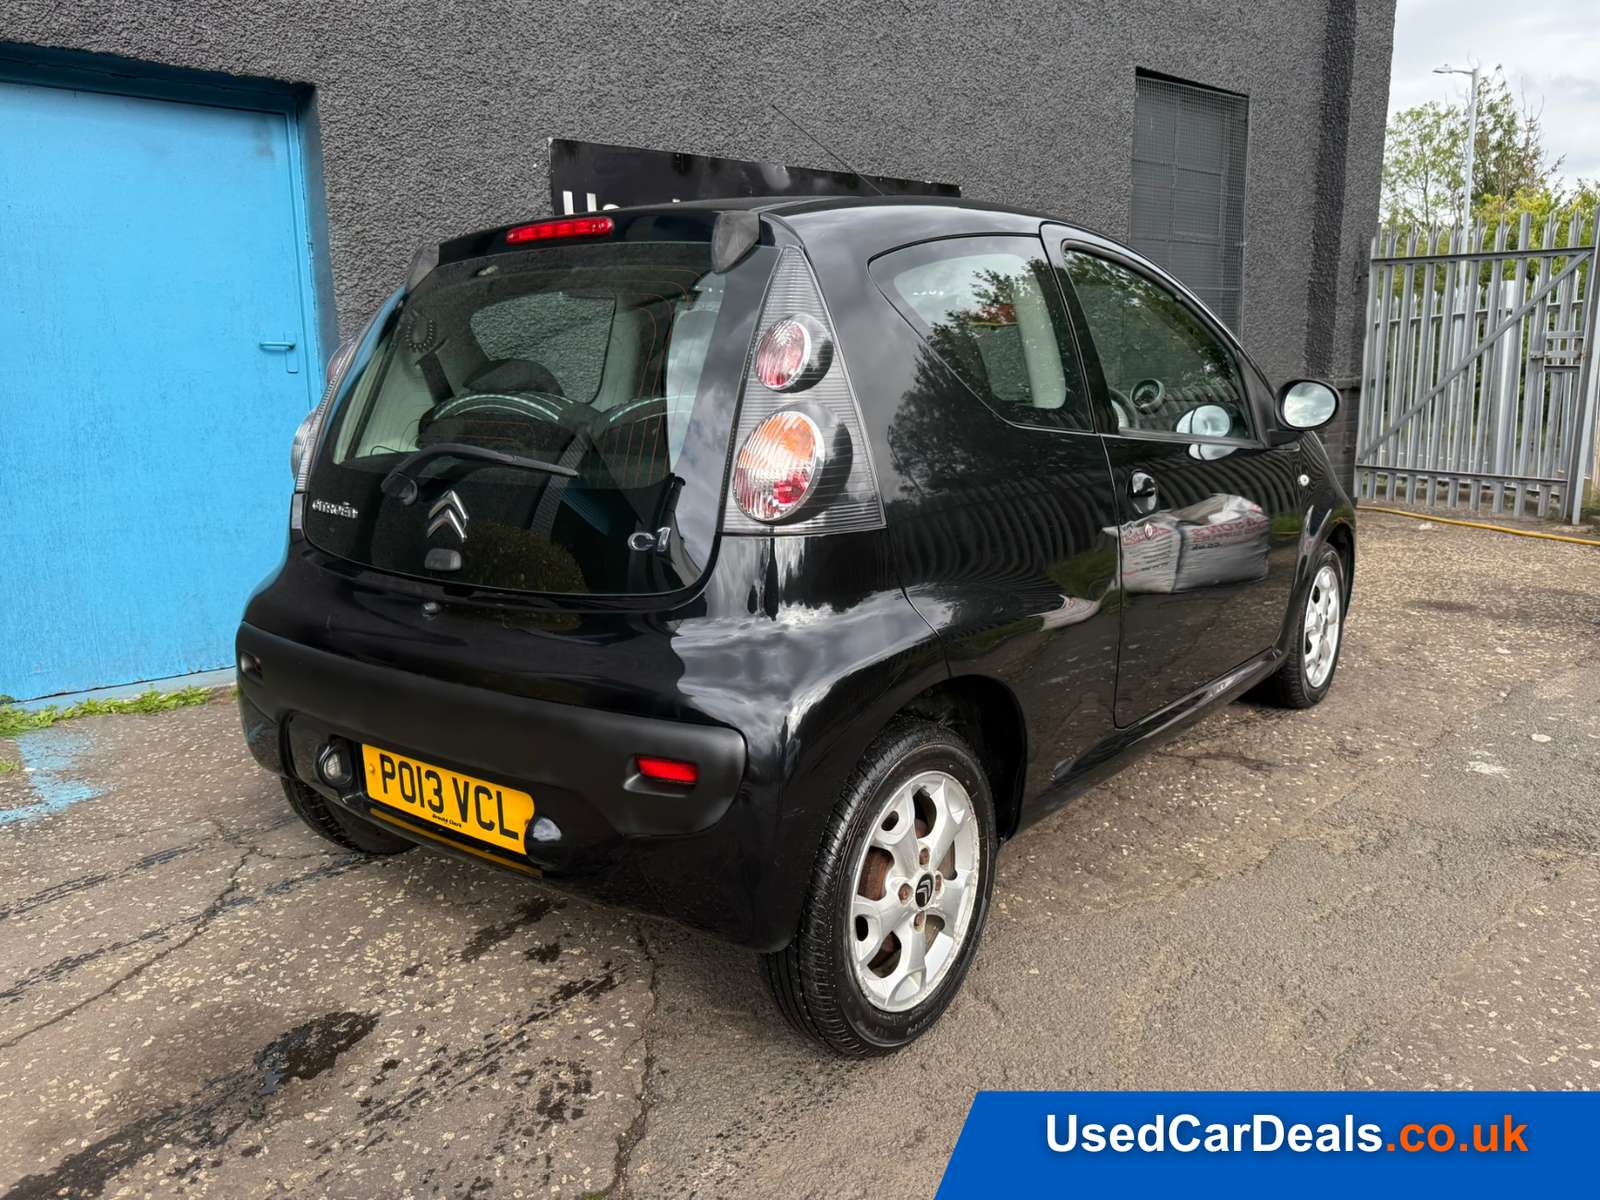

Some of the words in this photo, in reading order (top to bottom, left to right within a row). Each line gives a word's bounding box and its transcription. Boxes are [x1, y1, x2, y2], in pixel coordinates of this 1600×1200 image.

[627, 526, 671, 552] C1
[379, 753, 445, 814] PO13
[452, 776, 519, 840] VCL
